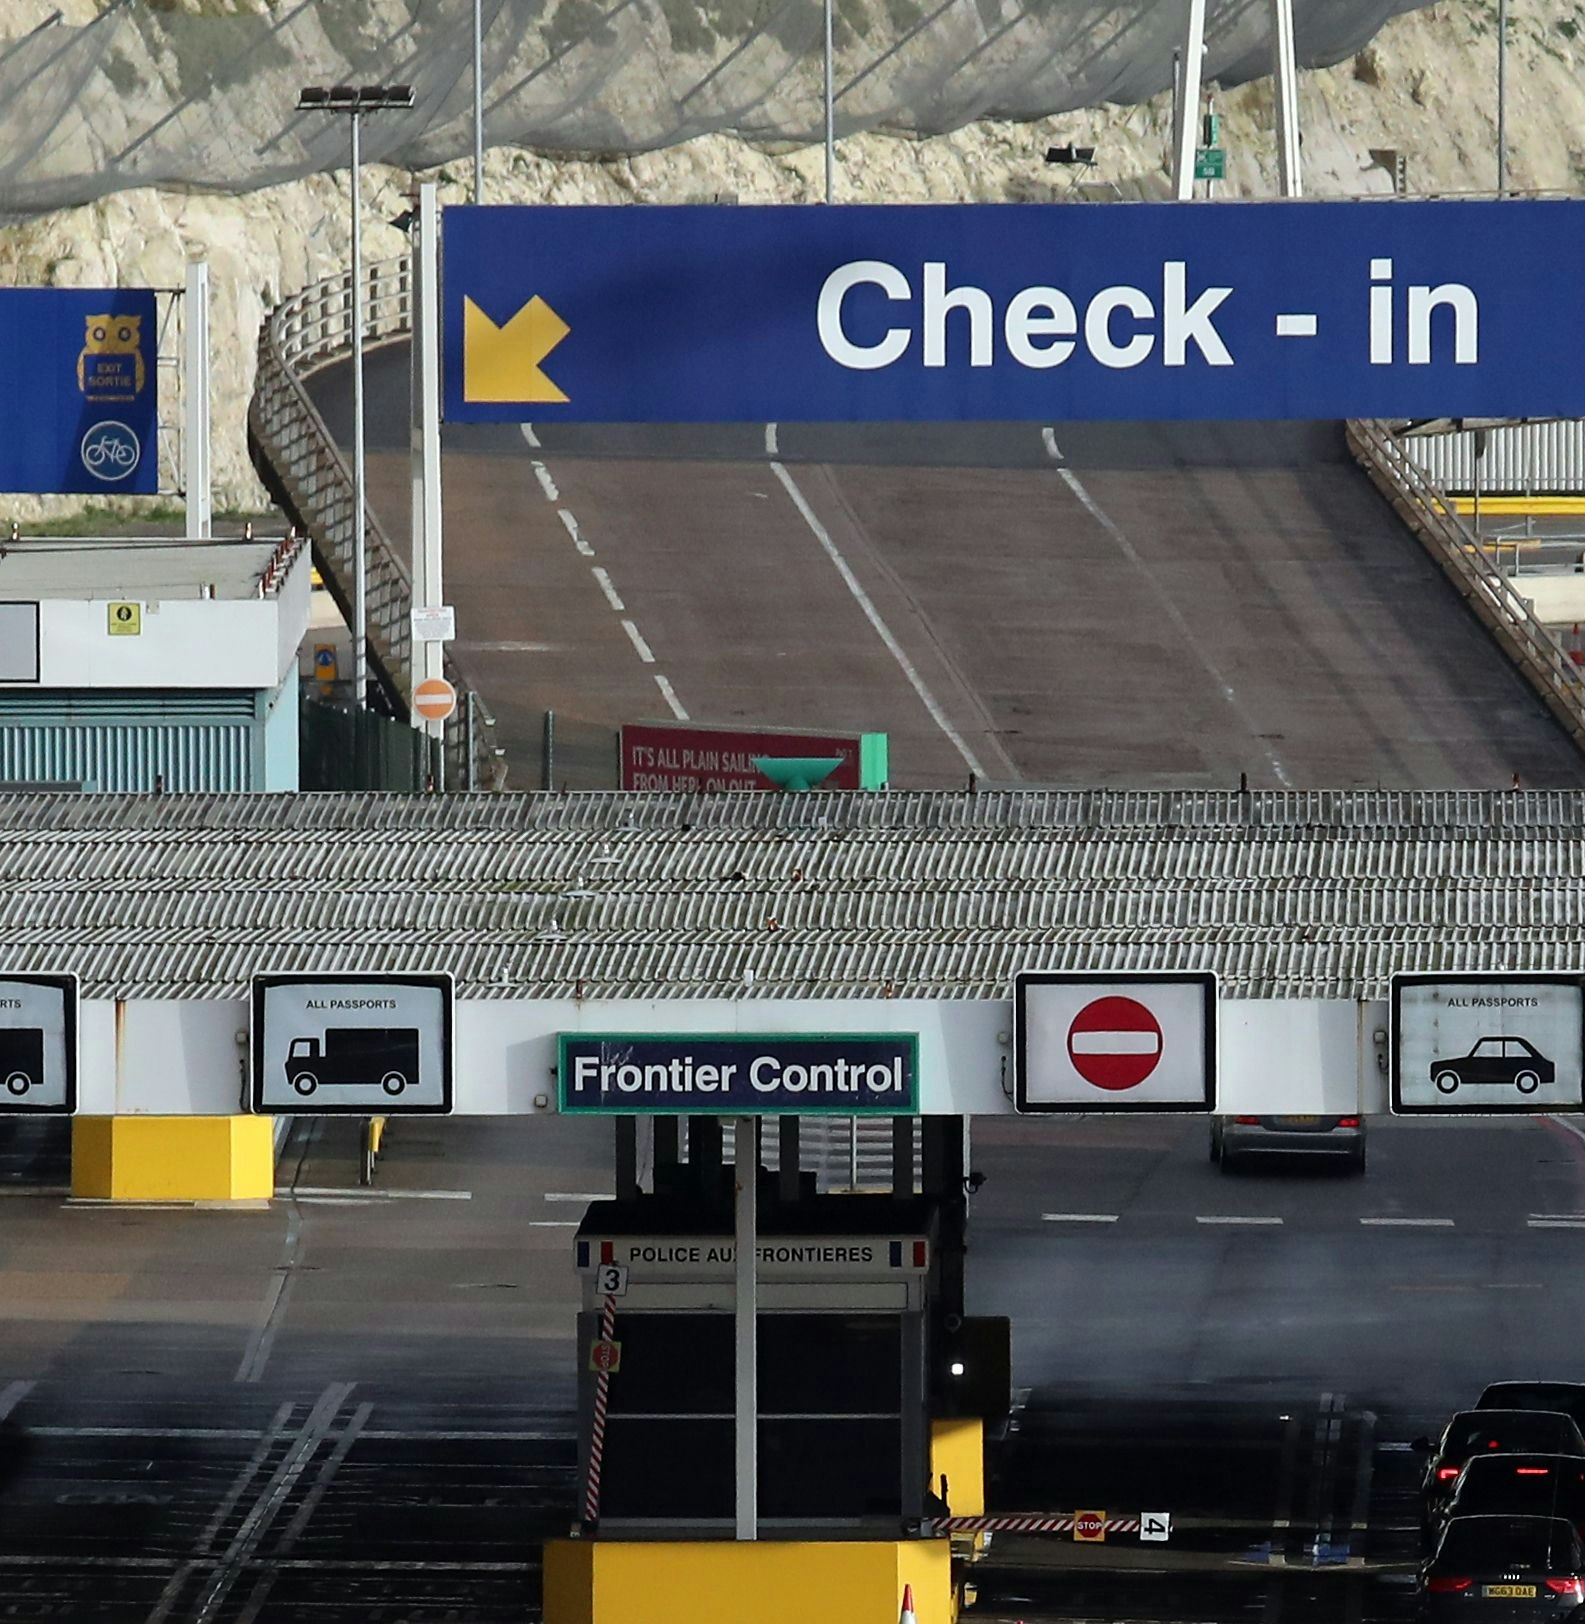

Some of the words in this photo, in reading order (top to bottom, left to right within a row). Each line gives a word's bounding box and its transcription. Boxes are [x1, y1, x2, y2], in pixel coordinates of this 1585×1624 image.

[818, 260, 1234, 370] Check
[1369, 259, 1477, 365] in
[656, 748, 680, 768] ALL
[683, 749, 719, 771] PLAIN
[722, 752, 770, 774] SAILI
[306, 998, 327, 1009] ALL
[330, 998, 397, 1009] PASSPORTS
[1447, 997, 1469, 1008] ALL
[1472, 997, 1538, 1008] PASSPORTS
[574, 1055, 736, 1092] Frontier
[750, 1055, 904, 1093] Control
[629, 1247, 700, 1262] POLICE
[706, 1247, 737, 1262] AU
[604, 1268, 621, 1291] 3
[1077, 1520, 1103, 1530] STOP
[1144, 1516, 1166, 1537] 4
